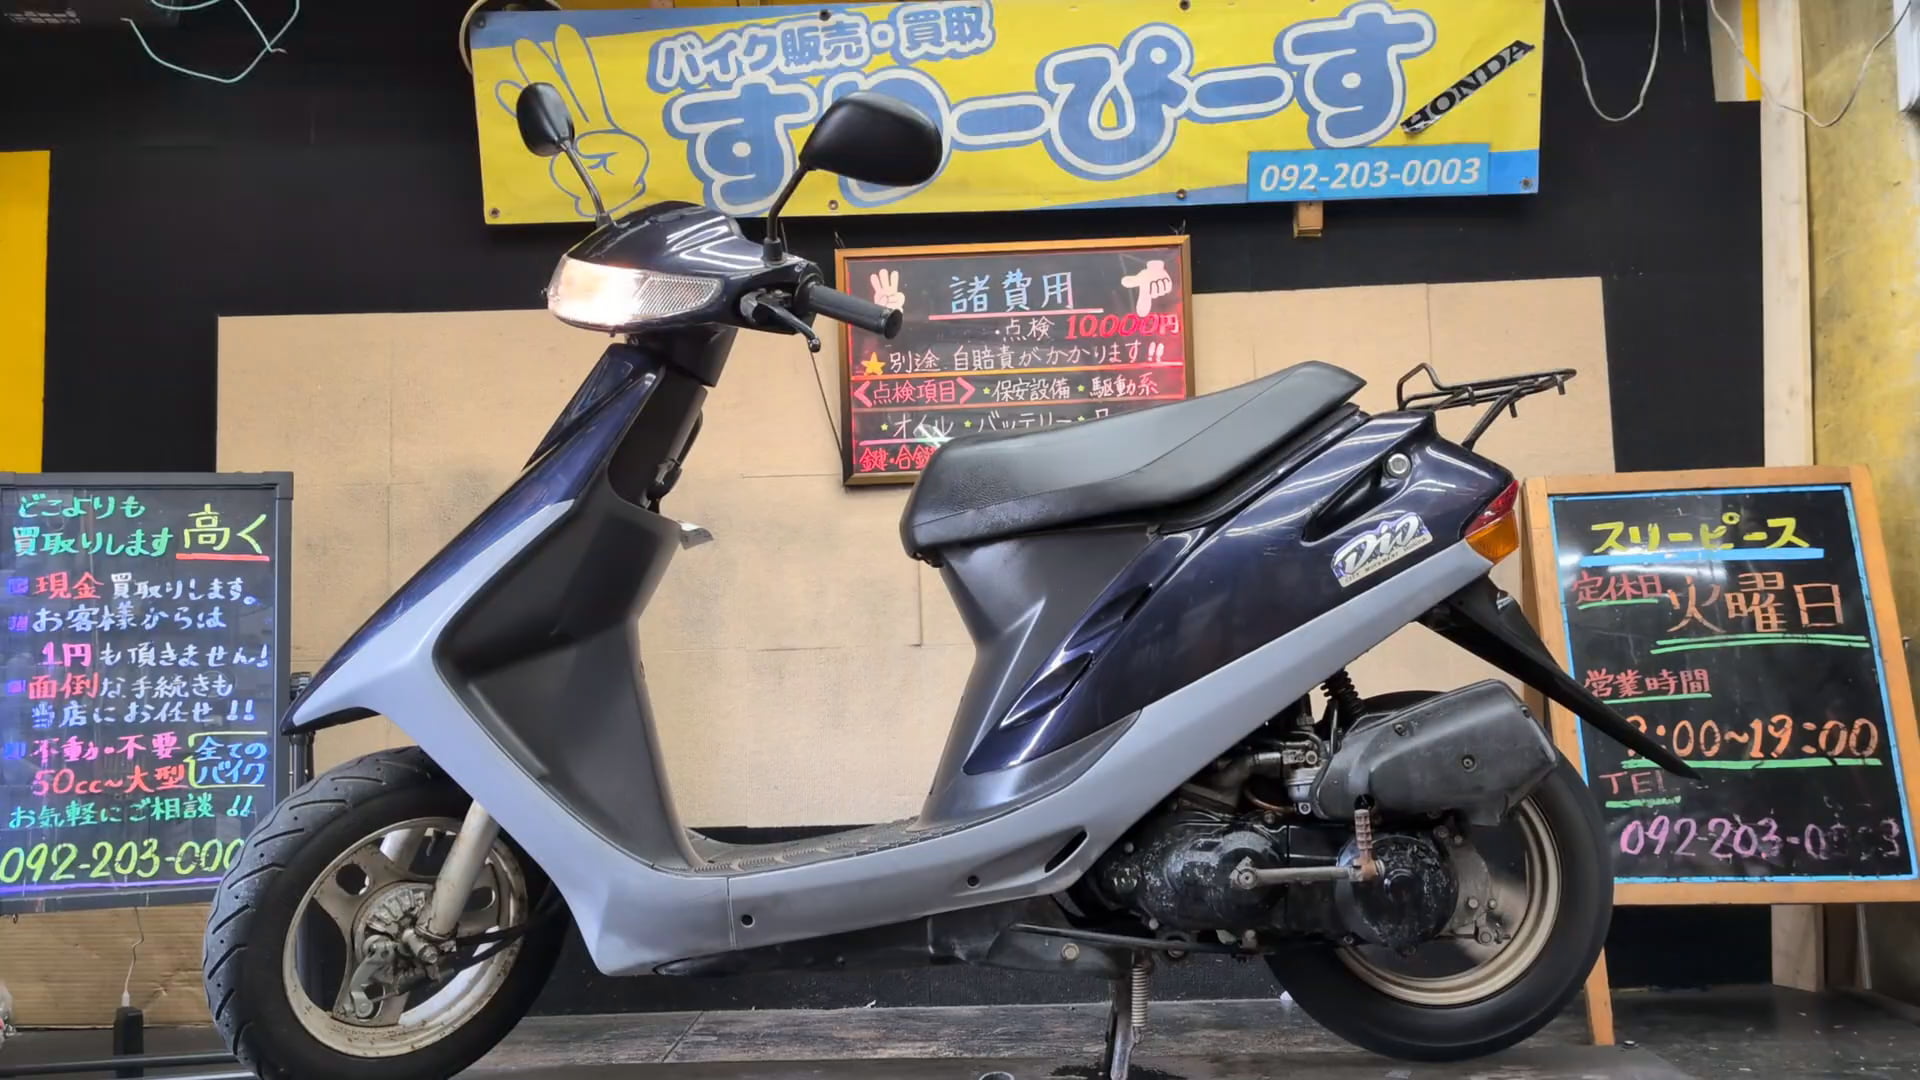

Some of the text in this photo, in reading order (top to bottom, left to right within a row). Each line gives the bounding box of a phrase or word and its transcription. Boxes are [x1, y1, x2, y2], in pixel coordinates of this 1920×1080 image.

[1400, 40, 1535, 134] HONDA
[1259, 157, 1482, 192] 092-203-0003
[949, 268, 1074, 313] 諸費用
[18, 493, 146, 519] どこよりも
[13, 526, 174, 557] 買取りします
[183, 503, 268, 554] 高く
[1591, 511, 1810, 553] スリーピース
[1571, 572, 1663, 603] 定休日
[1666, 571, 1844, 634] 火曜日
[1584, 668, 1711, 699] 営業時間
[196, 760, 265, 785] バイク
